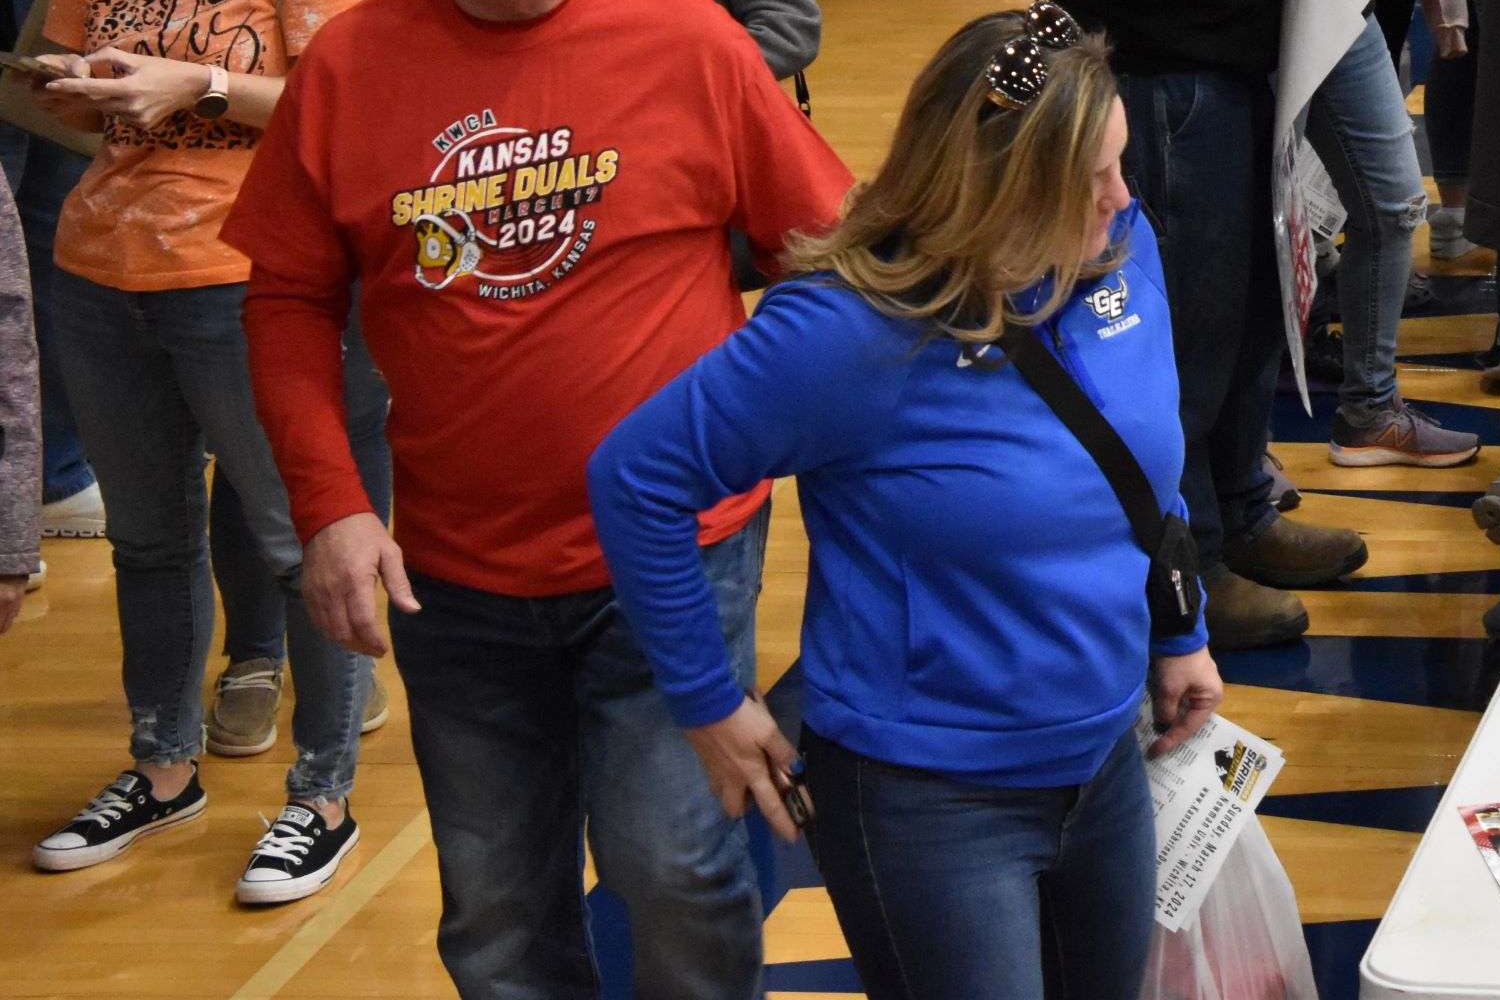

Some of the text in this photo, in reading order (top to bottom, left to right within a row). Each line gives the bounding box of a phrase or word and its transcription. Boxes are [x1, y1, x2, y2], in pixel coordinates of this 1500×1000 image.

[432, 108, 497, 153] KWCA
[457, 128, 571, 178] KANSAS
[392, 149, 619, 226] SHRINE DUALS
[488, 187, 599, 225] MARCH 17
[498, 208, 576, 249] 2024
[552, 218, 597, 280] KANSAS
[1092, 287, 1124, 319] GE
[1231, 748, 1257, 796] SHRINE
[1202, 795, 1229, 830] Newman
[1210, 803, 1242, 838] Sunday,
[1192, 842, 1217, 872] March
[1164, 891, 1186, 918] 2024
